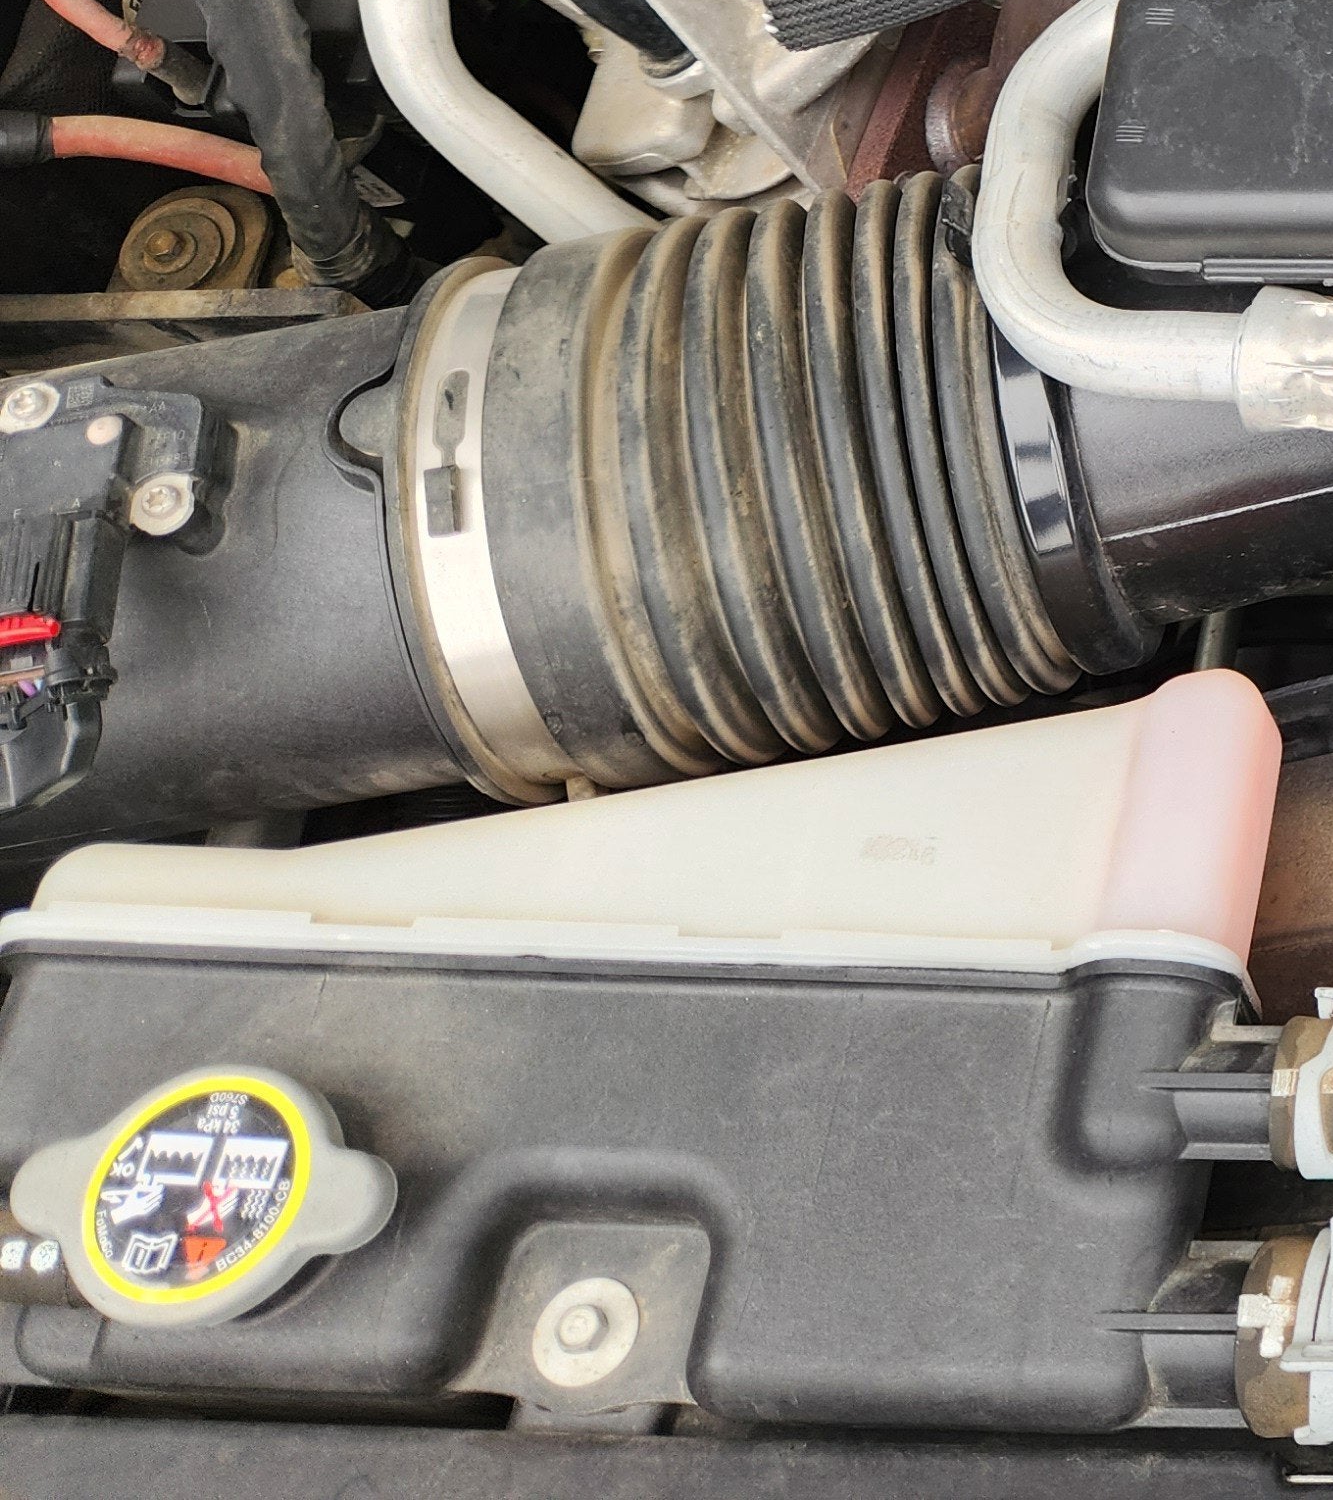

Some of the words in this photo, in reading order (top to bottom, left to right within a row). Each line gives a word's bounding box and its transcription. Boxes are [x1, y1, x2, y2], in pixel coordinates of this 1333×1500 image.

[206, 1104, 227, 1118] psi
[196, 1117, 221, 1133] kPa
[222, 1119, 241, 1134] 34
[109, 1162, 135, 1177] OK
